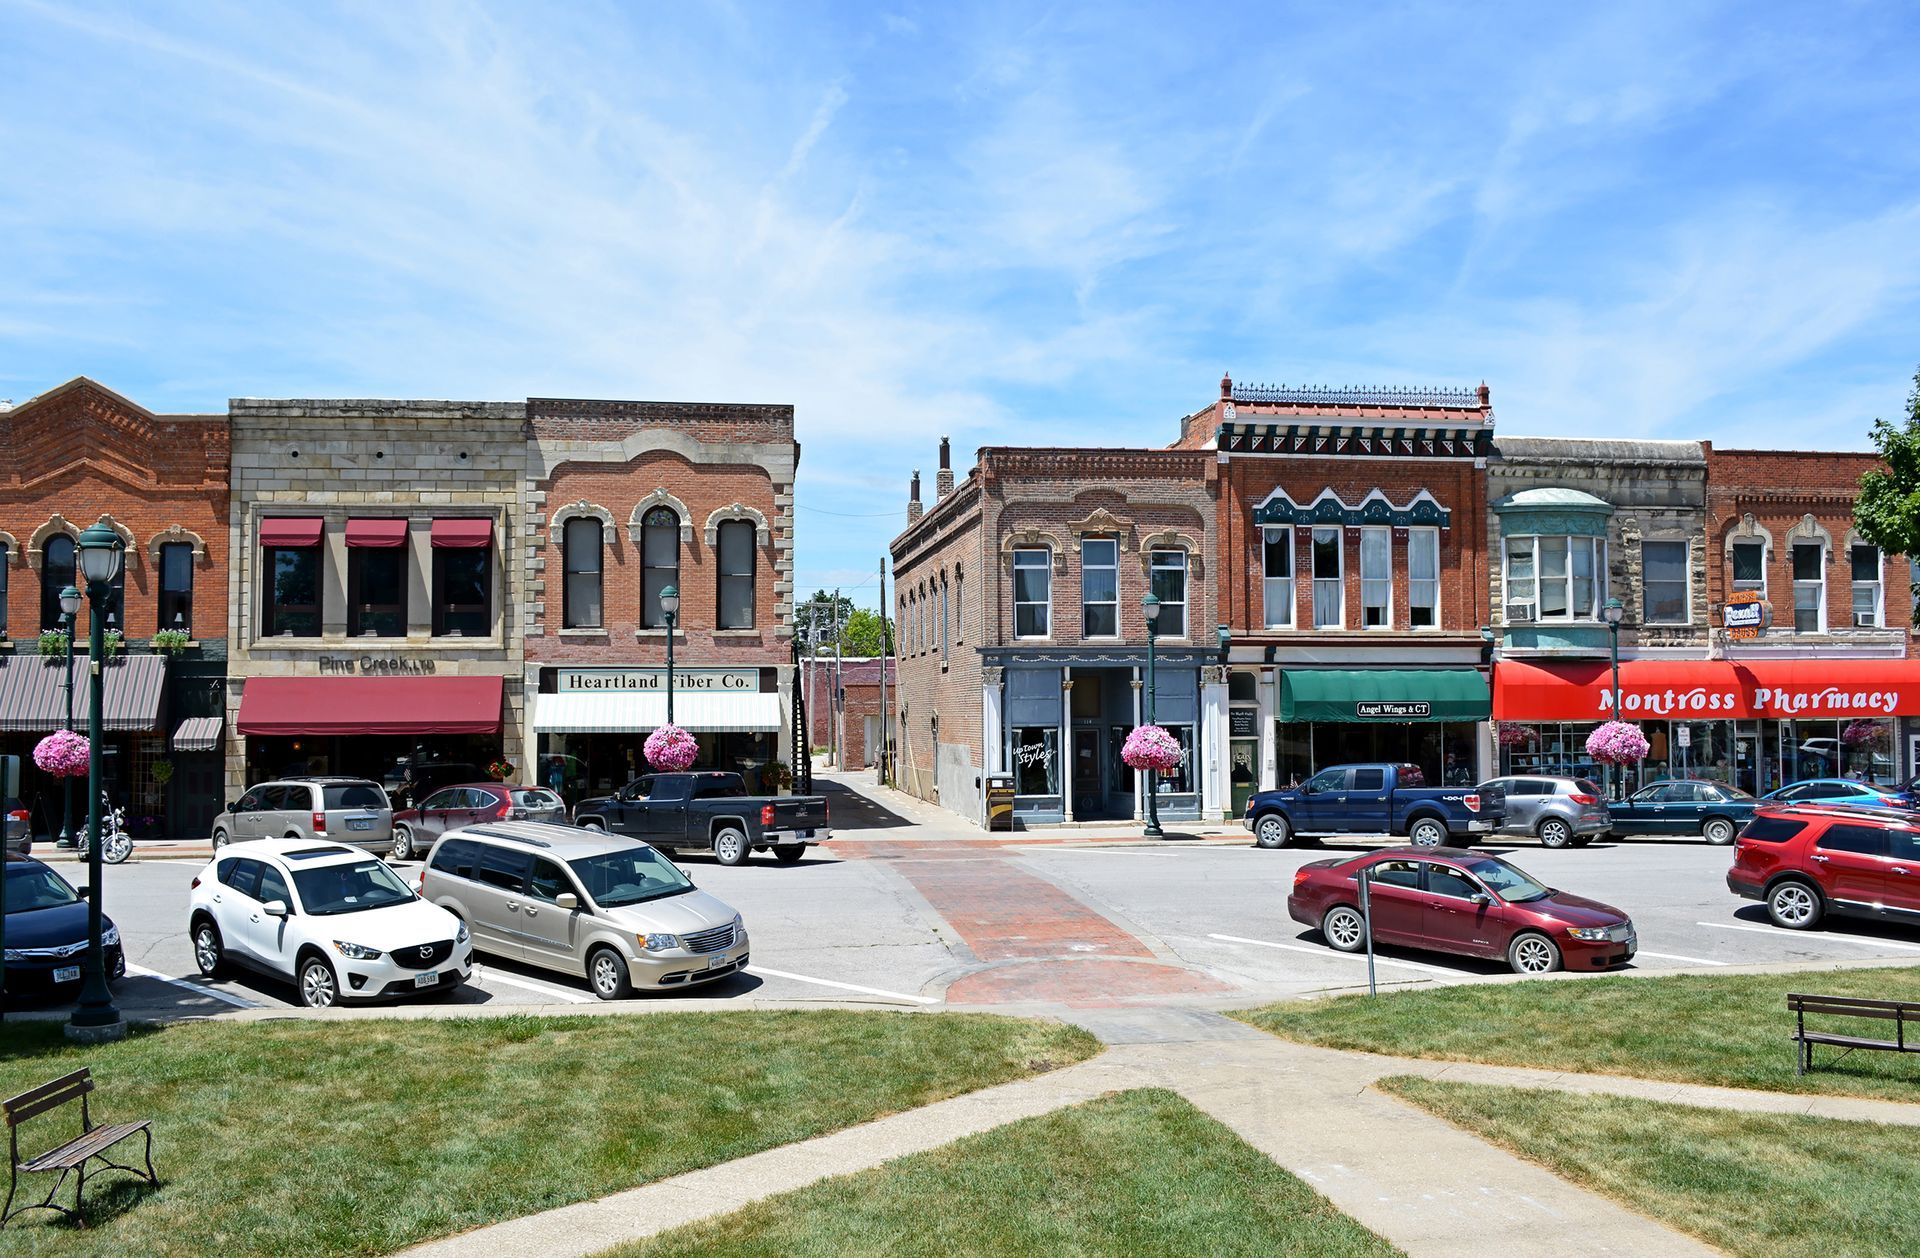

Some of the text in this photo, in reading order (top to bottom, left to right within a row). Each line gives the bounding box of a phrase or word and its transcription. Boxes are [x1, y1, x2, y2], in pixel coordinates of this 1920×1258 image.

[319, 655, 355, 672] Pine
[569, 674, 658, 689] Heartland
[722, 674, 750, 689] Co.
[1598, 687, 1898, 715] Montross Pharmacy
[1360, 705, 1427, 715] Angel Wings & CT
